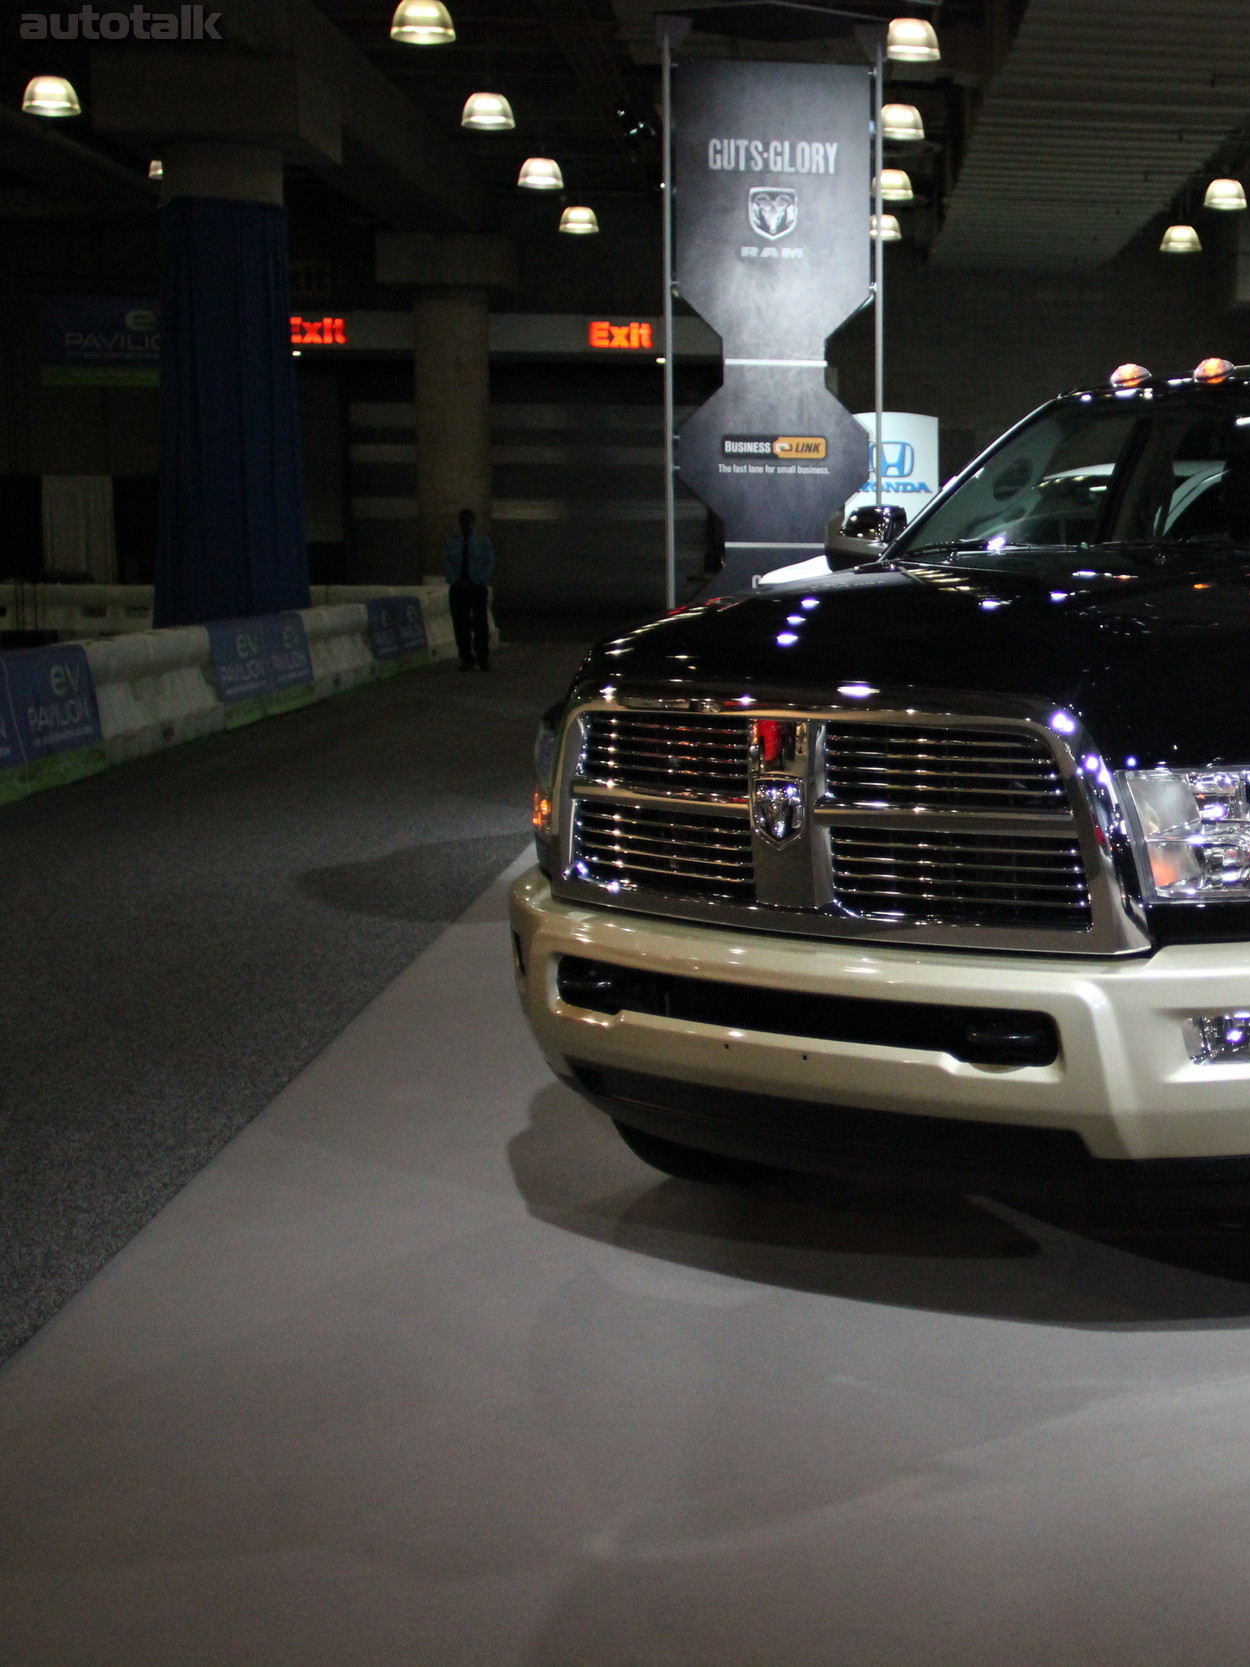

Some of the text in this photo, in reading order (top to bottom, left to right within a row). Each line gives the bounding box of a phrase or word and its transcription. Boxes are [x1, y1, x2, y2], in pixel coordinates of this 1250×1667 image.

[740, 246, 804, 258] RAM
[589, 321, 654, 349] Exit
[724, 440, 821, 454] BUSINESS LINK
[718, 464, 831, 475] The fast lane for small business.
[27, 698, 92, 734] PAVILION
